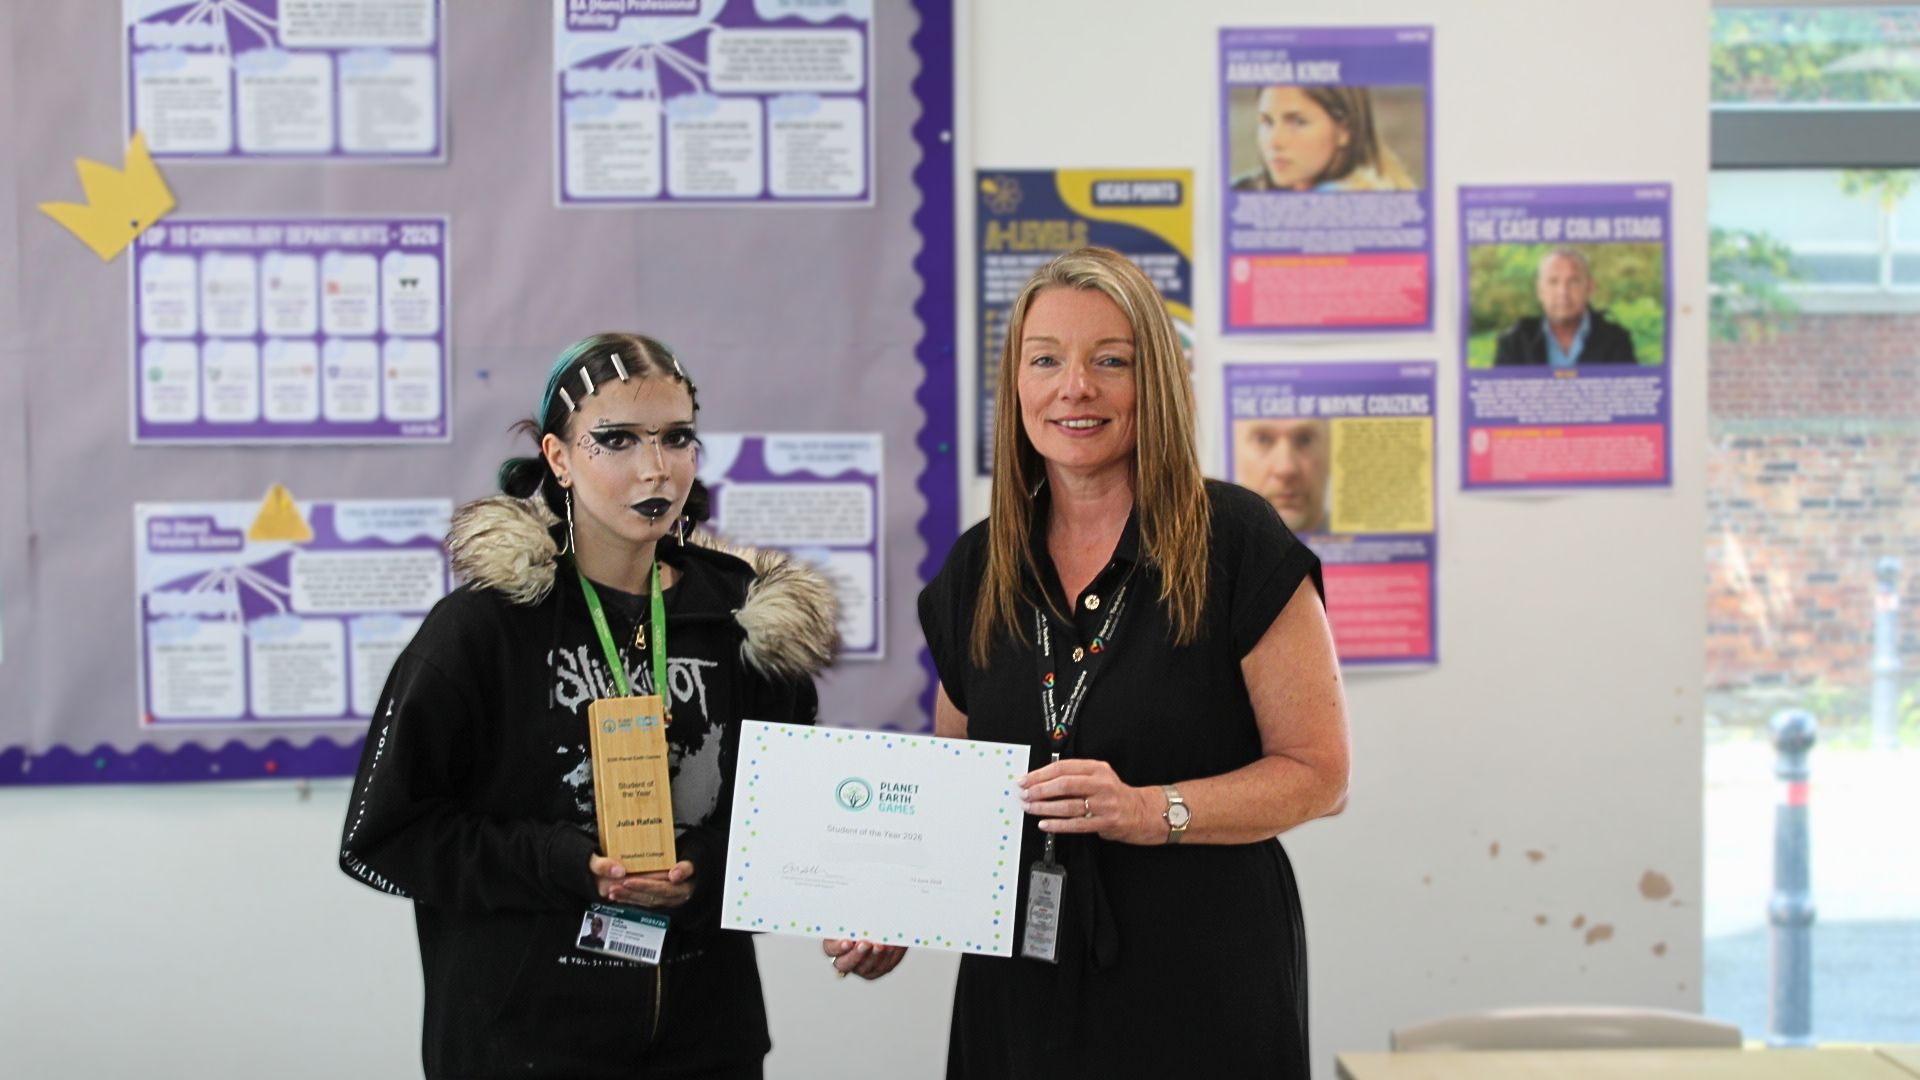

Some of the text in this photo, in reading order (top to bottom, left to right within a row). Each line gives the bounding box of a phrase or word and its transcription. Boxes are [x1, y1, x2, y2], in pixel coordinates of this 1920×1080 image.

[1228, 61, 1341, 83] AMANDA KNOX
[1467, 216, 1663, 240] THE CASE OF COLIN STAGG
[1233, 396, 1257, 416] THE
[1261, 396, 1296, 415] CASE
[1300, 396, 1315, 415] OF
[1319, 395, 1365, 415] WAYNE
[618, 781, 646, 789] Student
[880, 782, 919, 794] PLANET
[880, 793, 912, 804] EARTH
[879, 803, 915, 815] GAMES
[616, 820, 635, 828] Julia
[827, 825, 858, 834] Student
[859, 828, 868, 836] of
[869, 829, 882, 837] the
[884, 831, 902, 839] Year
